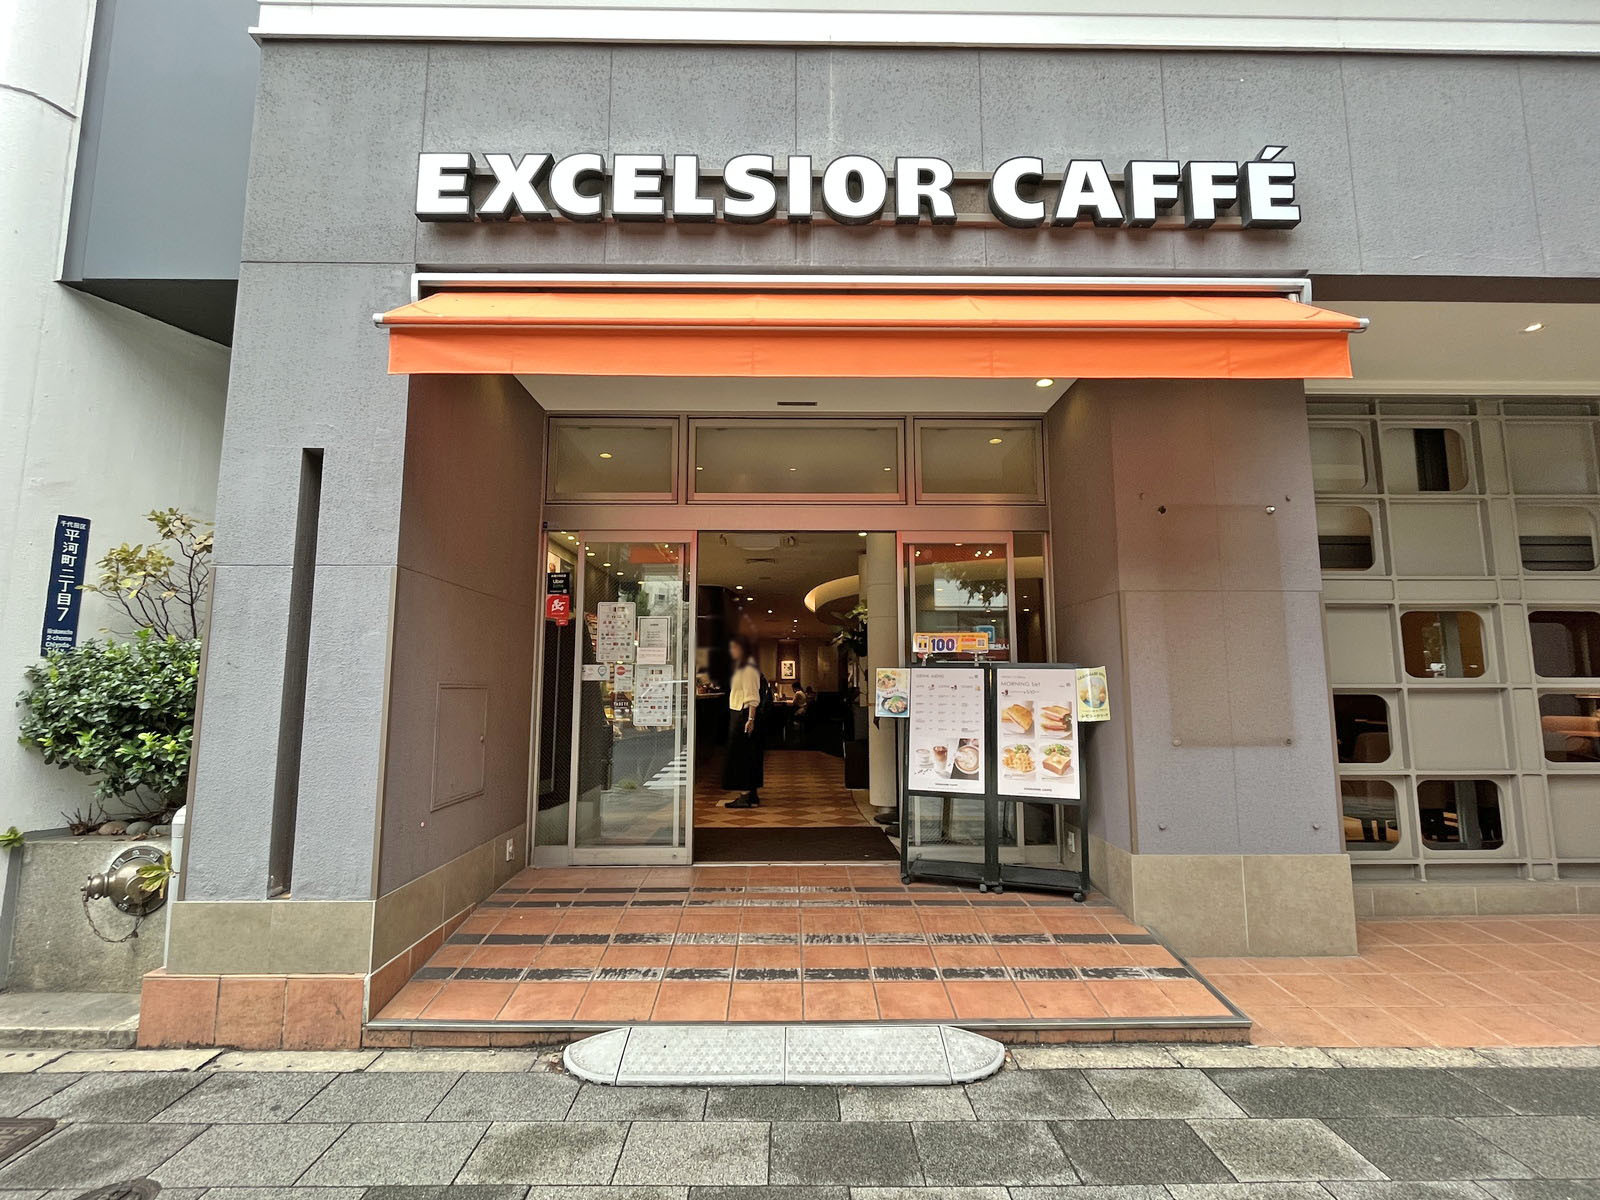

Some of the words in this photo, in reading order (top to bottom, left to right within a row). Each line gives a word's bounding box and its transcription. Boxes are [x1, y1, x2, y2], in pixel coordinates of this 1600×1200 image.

[415, 152, 957, 225] EXCELSIOR
[989, 145, 1301, 229] CAFFÉ
[930, 638, 956, 652] 100
